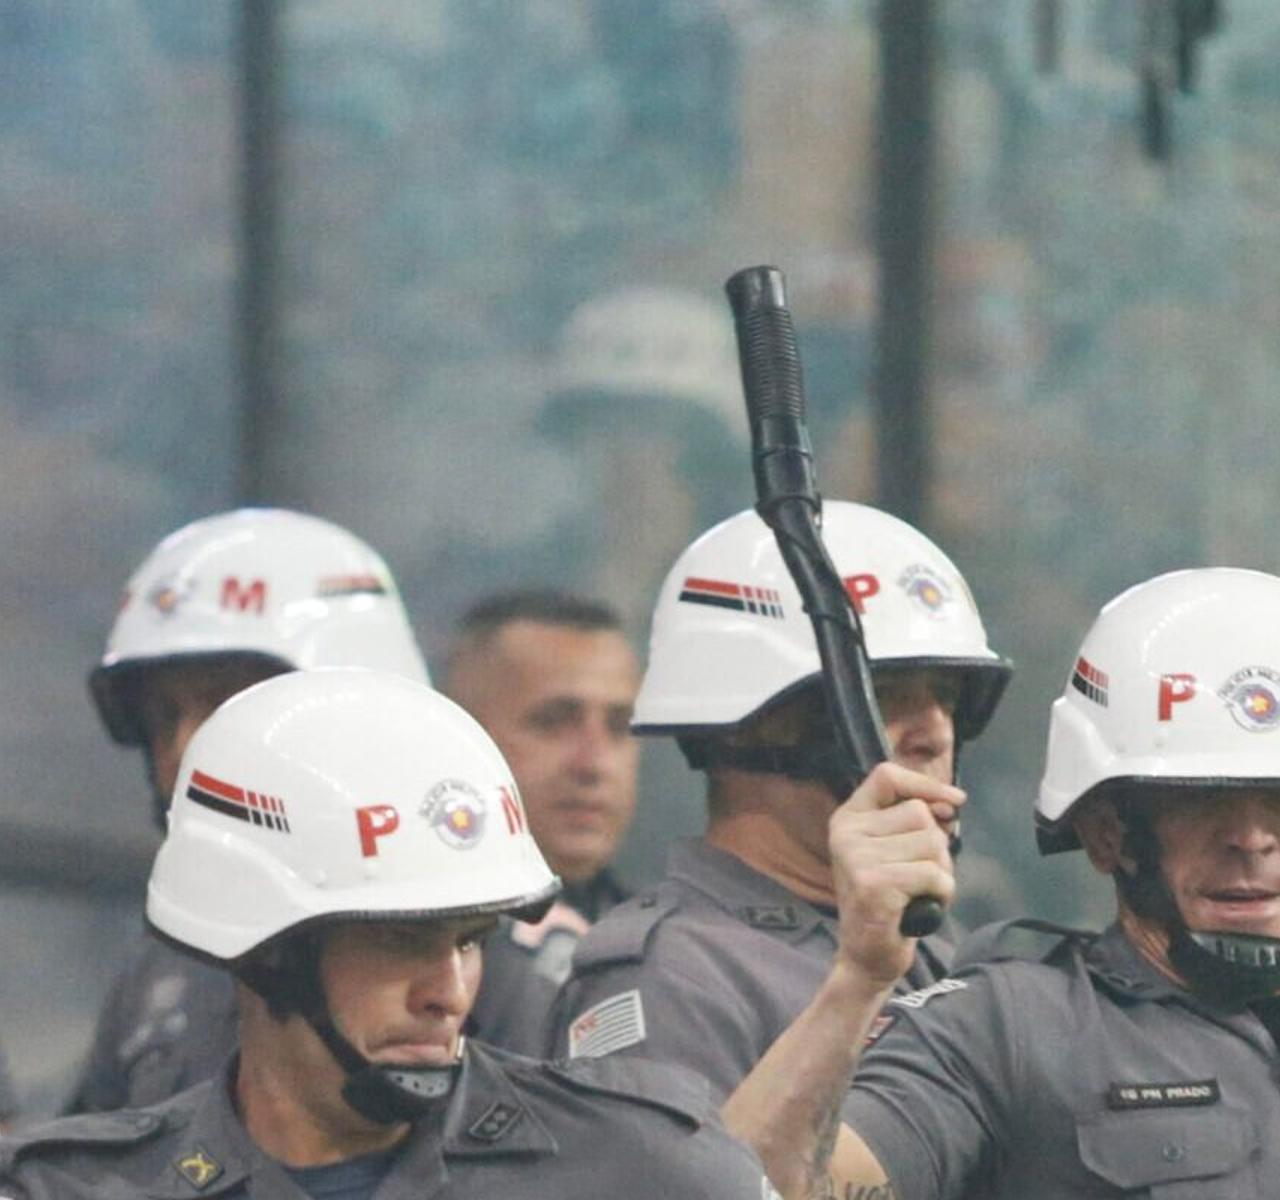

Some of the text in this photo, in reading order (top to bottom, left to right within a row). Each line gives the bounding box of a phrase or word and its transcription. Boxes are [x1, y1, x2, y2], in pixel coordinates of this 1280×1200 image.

[219, 575, 267, 617] M
[844, 572, 880, 615] P
[1158, 673, 1197, 722] P
[355, 804, 400, 858] P
[1165, 1085, 1212, 1099] PRADO
